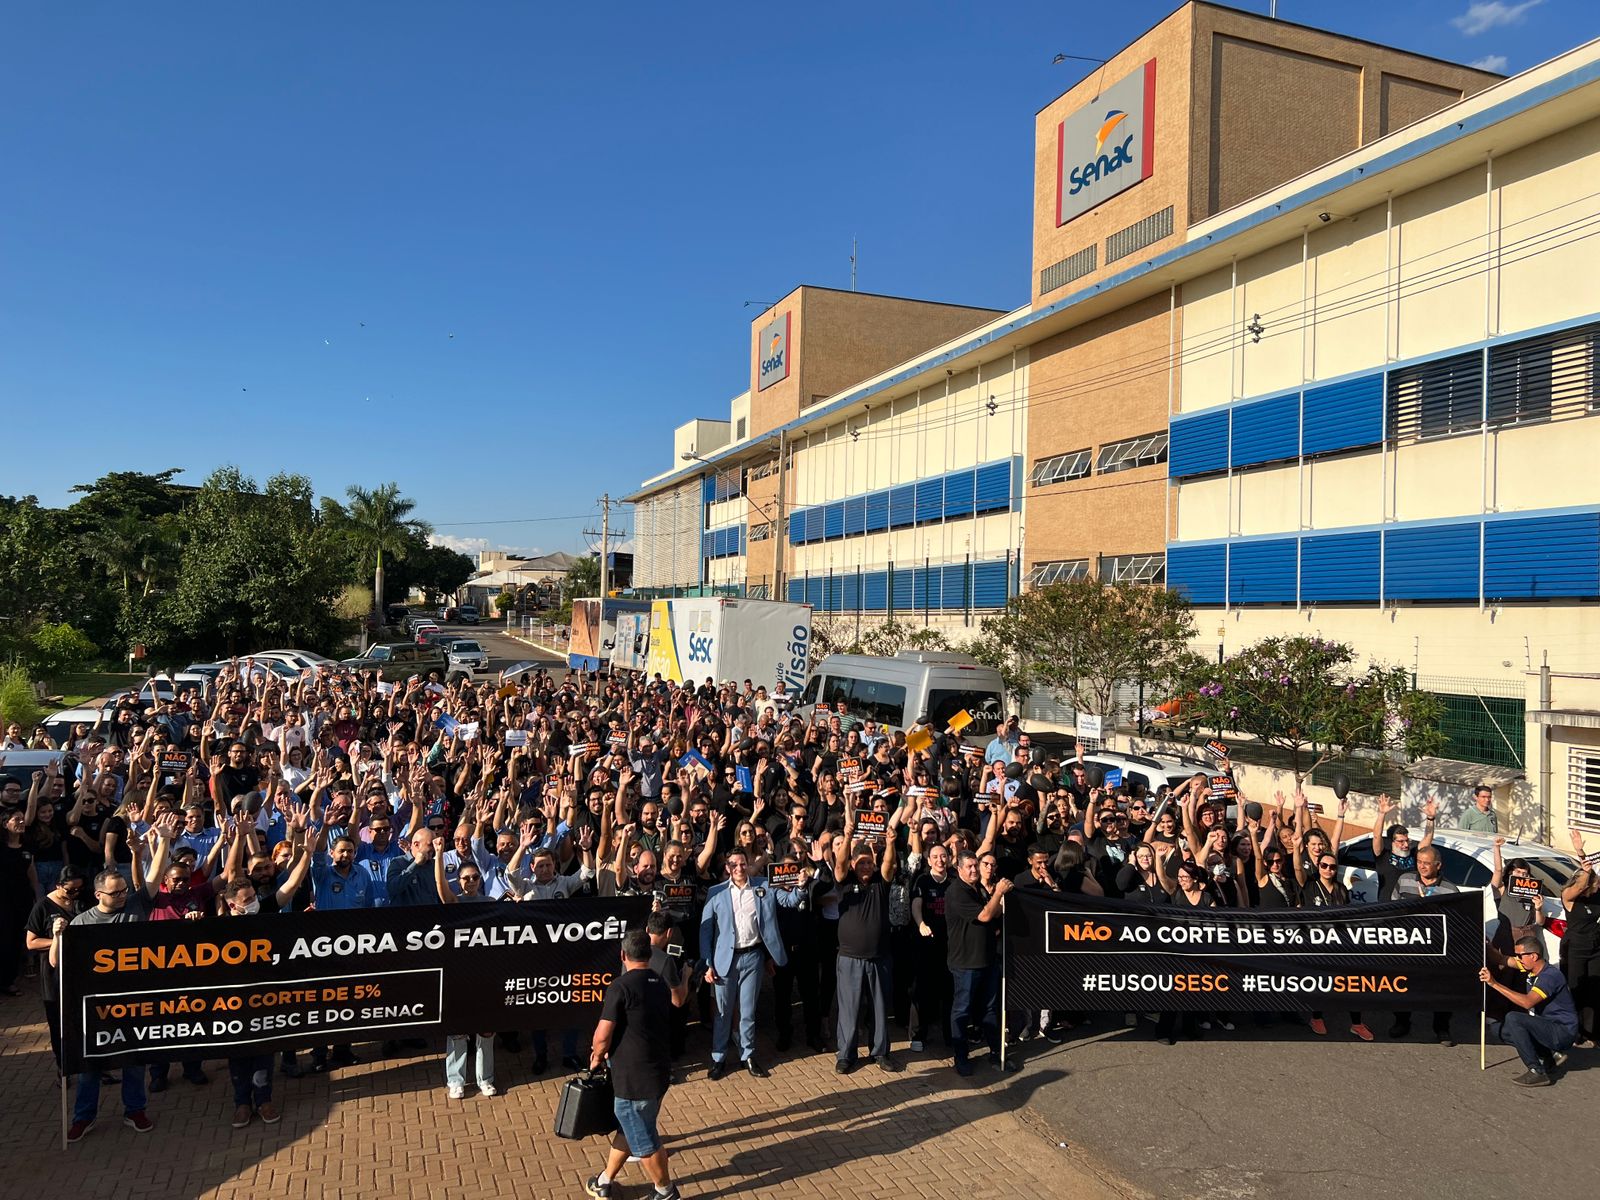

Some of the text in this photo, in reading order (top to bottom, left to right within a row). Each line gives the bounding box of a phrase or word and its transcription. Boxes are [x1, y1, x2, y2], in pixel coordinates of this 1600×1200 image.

[785, 625, 808, 692] Visão
[776, 662, 784, 680] úde
[969, 709, 1002, 720] Senac
[165, 753, 187, 761] NÃO
[1213, 776, 1230, 784] NÃO
[861, 812, 884, 824] NÃO
[774, 864, 798, 875] NÃO
[670, 886, 692, 896] NÃO
[1515, 878, 1538, 889] NÃO
[1064, 921, 1432, 945] NÃO AO CORTE DE 5% DA VERBA!
[93, 916, 627, 972] SENADOR, AGORA SÓ FALTA VOCÊ!
[505, 973, 612, 991] #EUSOUSESC
[1083, 974, 1408, 992] #EUSOUSESC #EUSOUSENAC
[96, 984, 381, 1020] VOTE NÃO AO CORTE DE 5%
[505, 990, 602, 1005] #EUSOUSEN
[96, 1004, 424, 1046] DA VERBA DO SESC E DO SENAC
